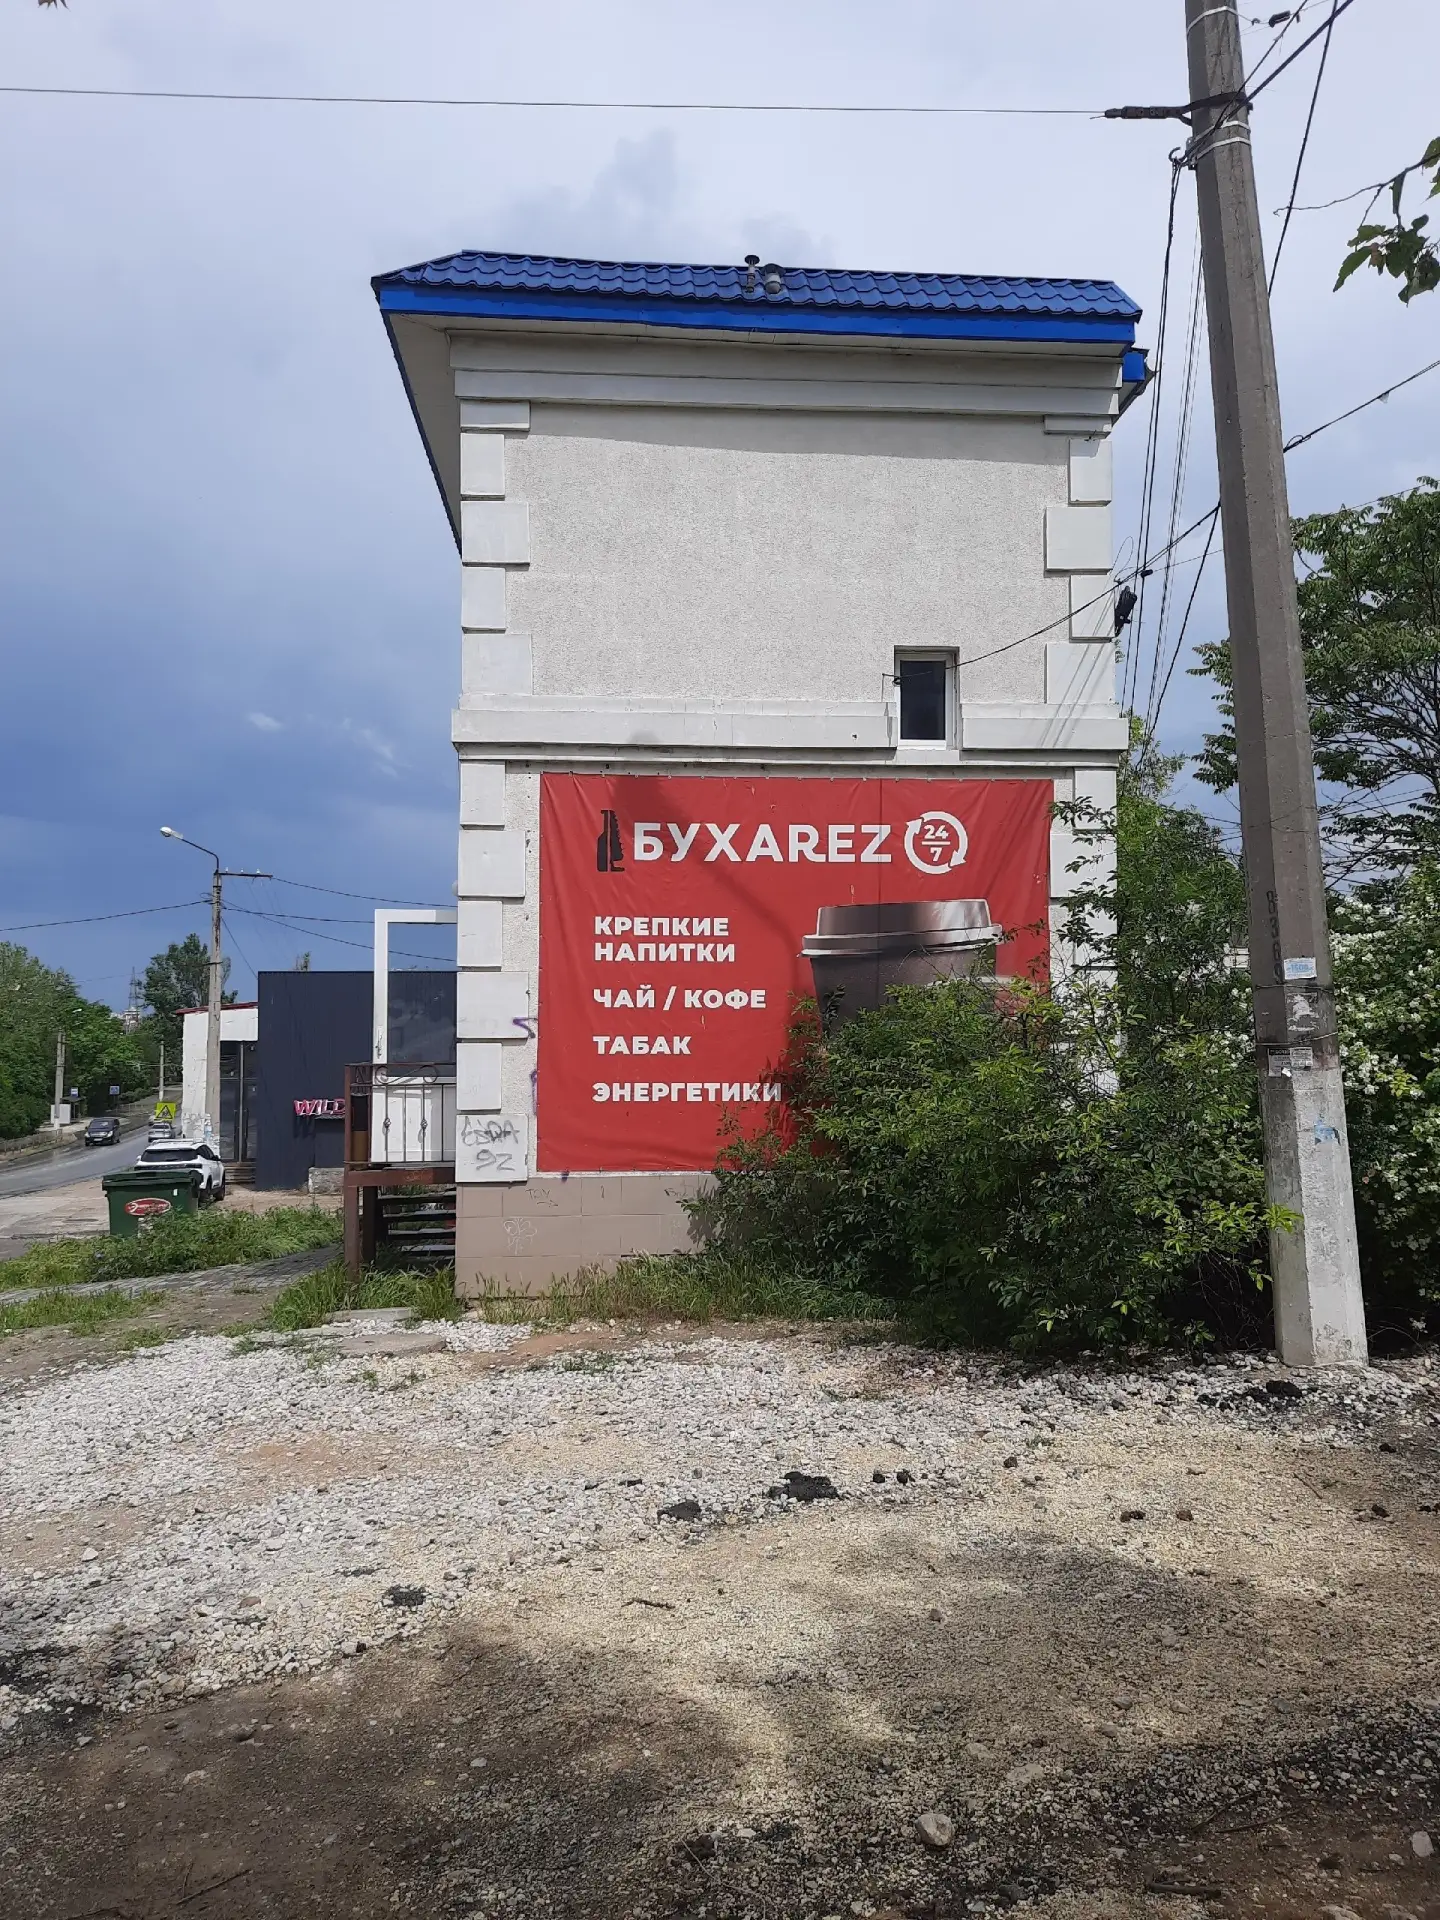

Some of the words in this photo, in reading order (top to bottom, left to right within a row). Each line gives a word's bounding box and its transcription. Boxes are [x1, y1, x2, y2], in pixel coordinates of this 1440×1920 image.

[924, 824, 949, 839] 24
[930, 847, 942, 861] 7
[595, 916, 728, 936] КРЕПКИЕ
[595, 943, 734, 962] НАПИТКИ
[594, 985, 654, 1007] ЧАЙ
[685, 989, 766, 1009] КОФЕ
[593, 1036, 691, 1054] ТАБАК
[593, 1083, 781, 1102] ЭНЕРГЕТИКИ
